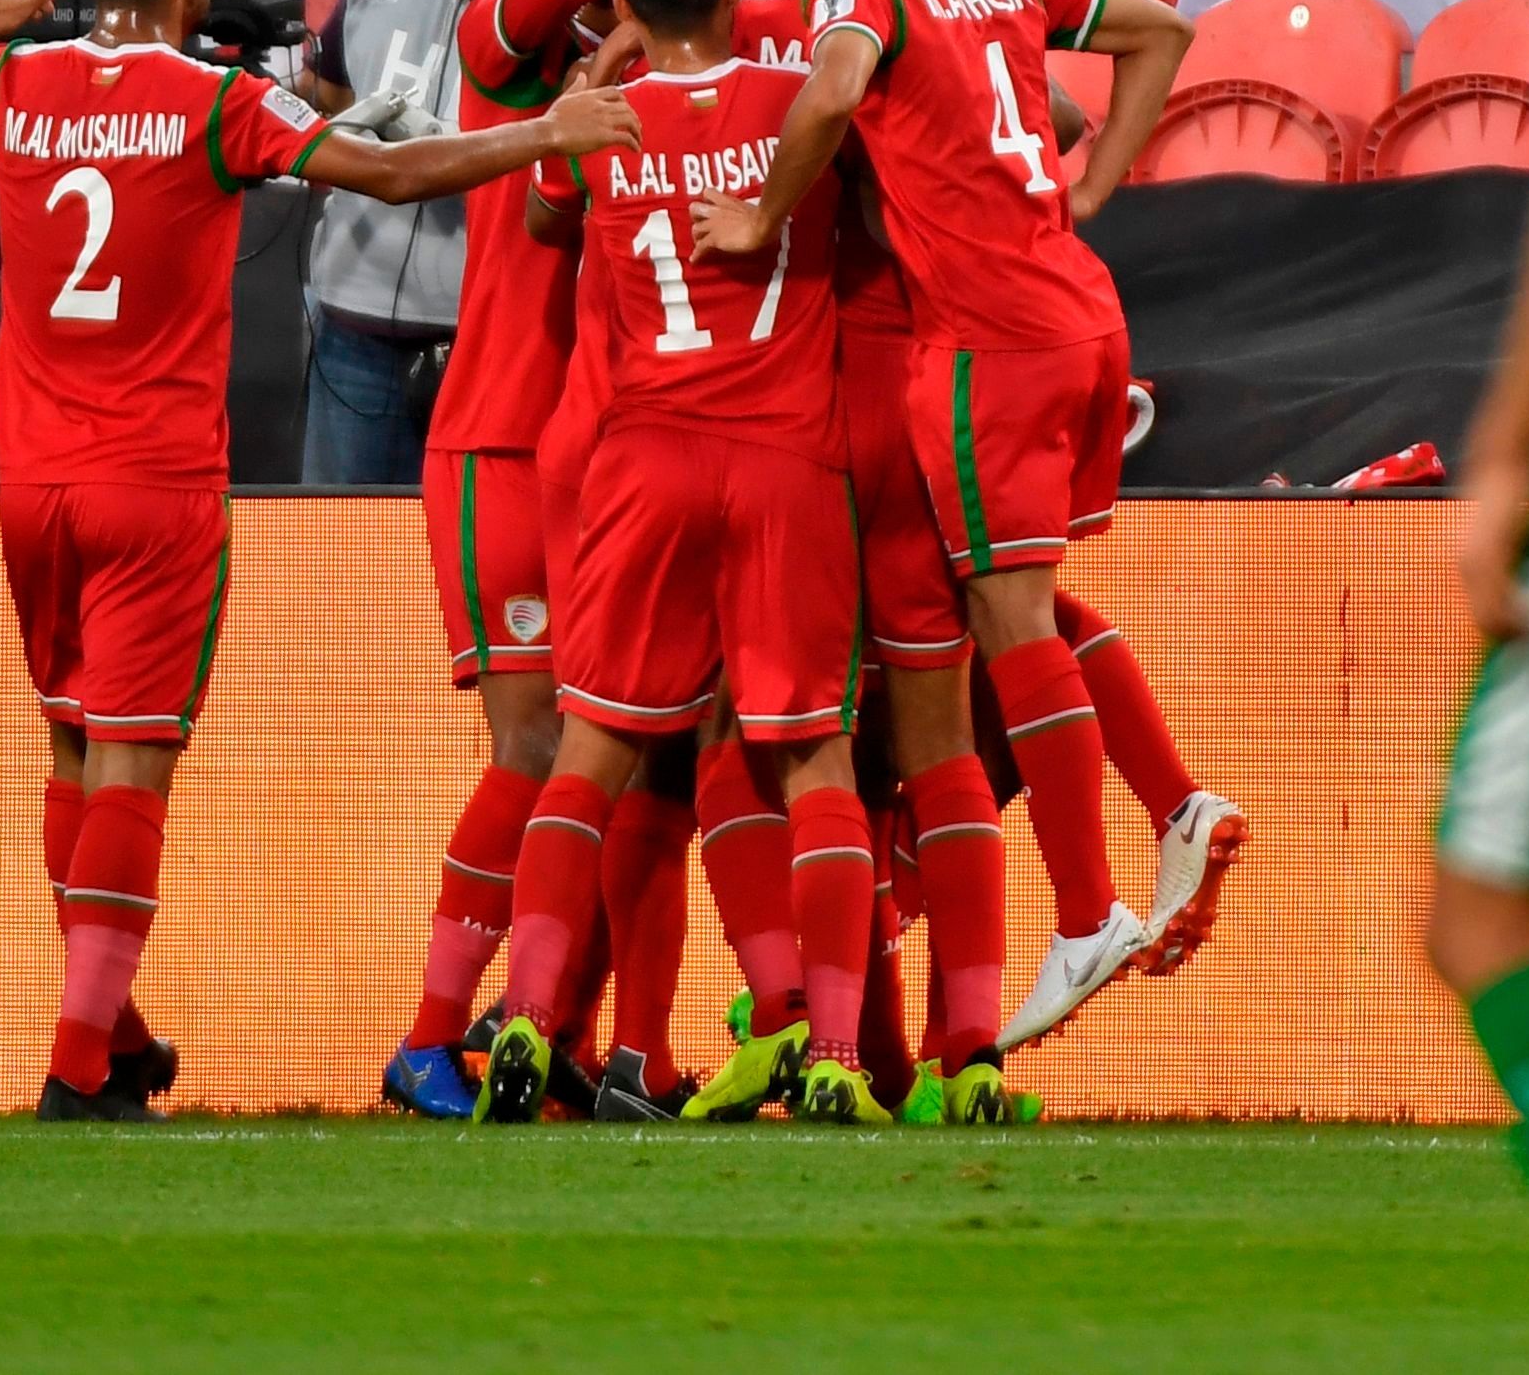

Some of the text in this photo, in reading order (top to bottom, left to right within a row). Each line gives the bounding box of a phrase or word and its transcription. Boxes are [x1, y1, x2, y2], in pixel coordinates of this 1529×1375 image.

[52, 8, 75, 23] UHD
[5, 107, 186, 159] M.AL MUSALLAMI
[985, 40, 1058, 194] 4
[610, 152, 676, 199] A.AL
[45, 166, 122, 321] 2
[631, 196, 793, 353] 17
